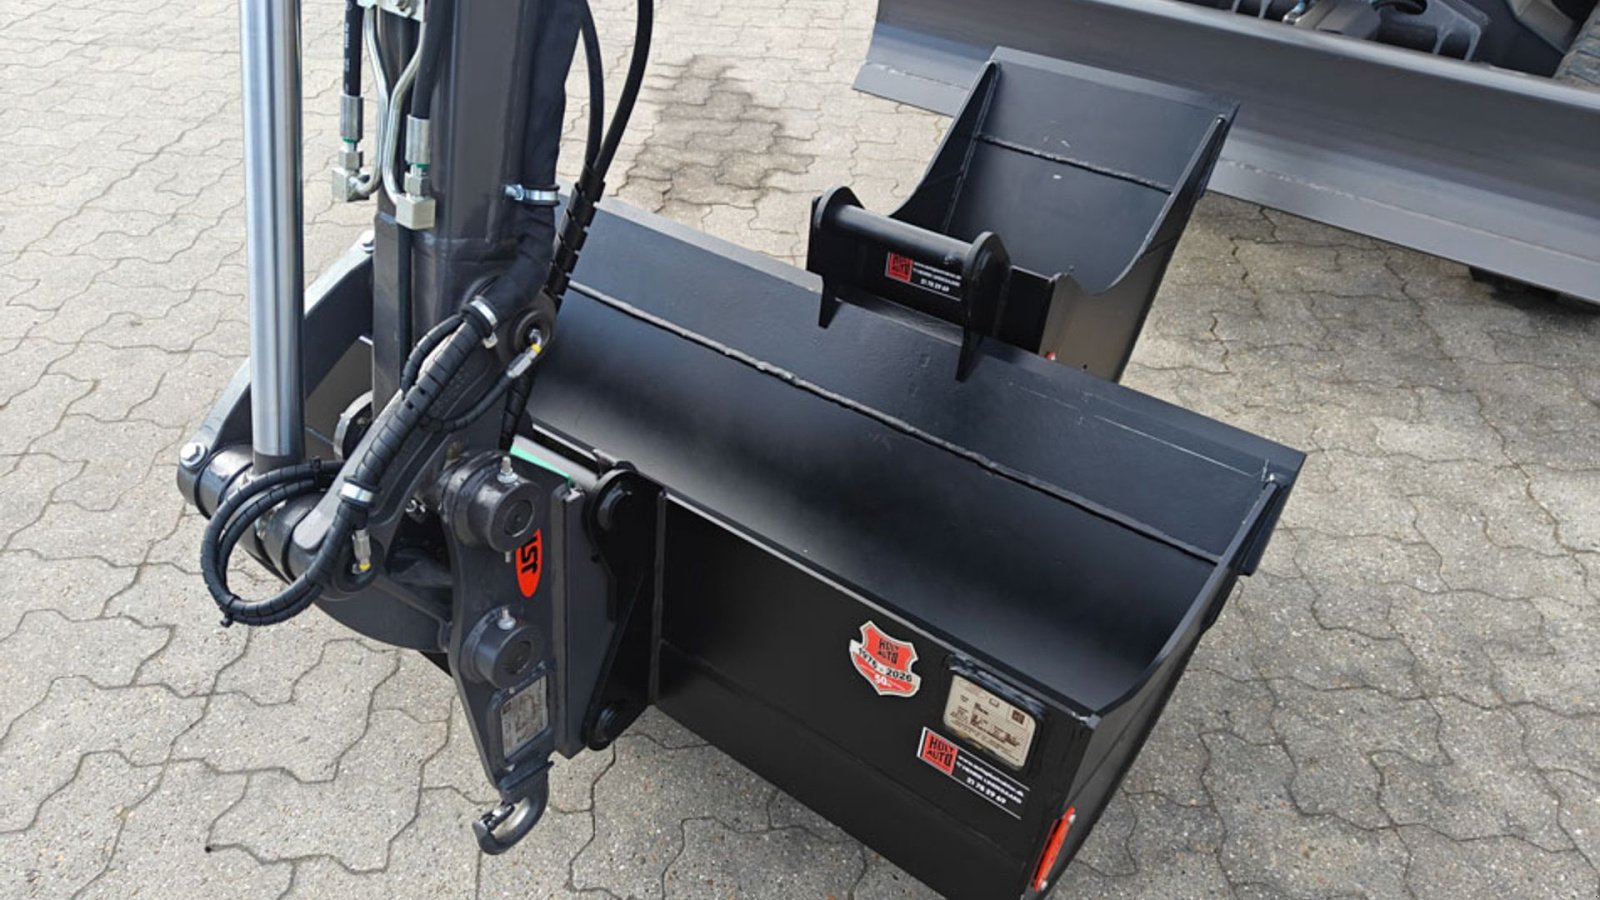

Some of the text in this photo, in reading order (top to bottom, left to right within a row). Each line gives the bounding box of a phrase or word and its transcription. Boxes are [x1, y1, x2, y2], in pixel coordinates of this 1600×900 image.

[886, 667, 913, 682] 2026
[929, 736, 956, 754] HOLY
[927, 750, 953, 767] AUTO
